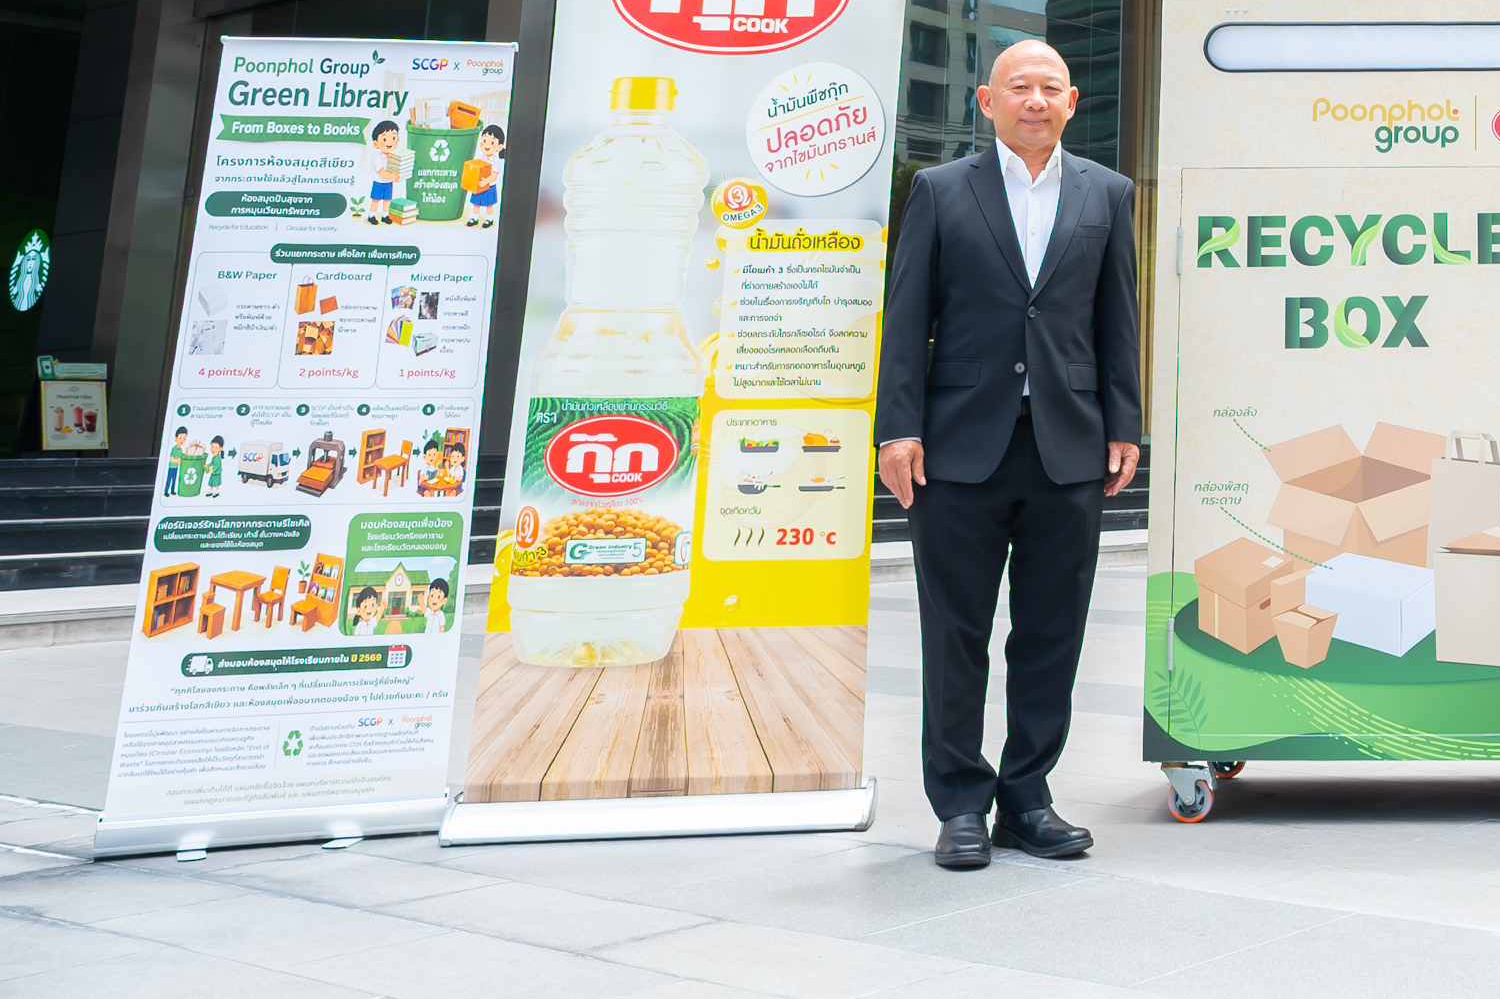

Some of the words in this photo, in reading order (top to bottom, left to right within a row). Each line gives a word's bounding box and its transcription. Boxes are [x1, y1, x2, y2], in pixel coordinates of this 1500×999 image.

[733, 17, 788, 33] COOK
[234, 56, 314, 77] Poonphol
[320, 58, 370, 78] Group
[412, 58, 448, 70] SCGP
[467, 59, 503, 68] Poonphol
[483, 67, 503, 76] group
[228, 80, 309, 108] Green
[319, 82, 409, 116] Library
[768, 81, 849, 118] น้ำมันพืชกุ๊ก
[1312, 97, 1460, 126] Poonphol
[232, 121, 264, 134] From
[267, 122, 304, 135] Boxes
[307, 123, 320, 135] to
[323, 123, 360, 136] Books
[766, 104, 868, 154] ปลอดภัย
[1375, 124, 1459, 153] group
[765, 125, 877, 173] จากไขมันทรานส์
[217, 155, 354, 170] โครงการห้องสมุดสีเขียว
[723, 208, 756, 222] OMEGA
[755, 203, 763, 213] 3
[750, 227, 861, 250] น้ำมันถั่วเหลือง
[218, 271, 243, 279] B&W
[246, 271, 277, 281] Paper
[316, 271, 372, 281] Cardboard
[778, 266, 783, 274] 3
[444, 274, 473, 283] Paper
[1285, 295, 1429, 349] BOX
[199, 368, 206, 376] 4
[209, 367, 260, 379] points/kg
[299, 368, 306, 377] 2
[309, 367, 359, 379] points/kg
[399, 368, 404, 377] 1
[407, 368, 456, 379] points/kg
[536, 411, 557, 423] ตรา
[1213, 406, 1257, 417] กล่องลัง
[243, 453, 263, 462] SCGP
[612, 473, 642, 483] COOK
[1194, 480, 1249, 494] กล่องพัสดุ
[1201, 497, 1242, 505] กระดาษ
[776, 528, 814, 546] 230
[632, 542, 642, 557] 5
[359, 653, 382, 661] 2569
[358, 717, 383, 727] SCGP
[415, 721, 432, 729] group
